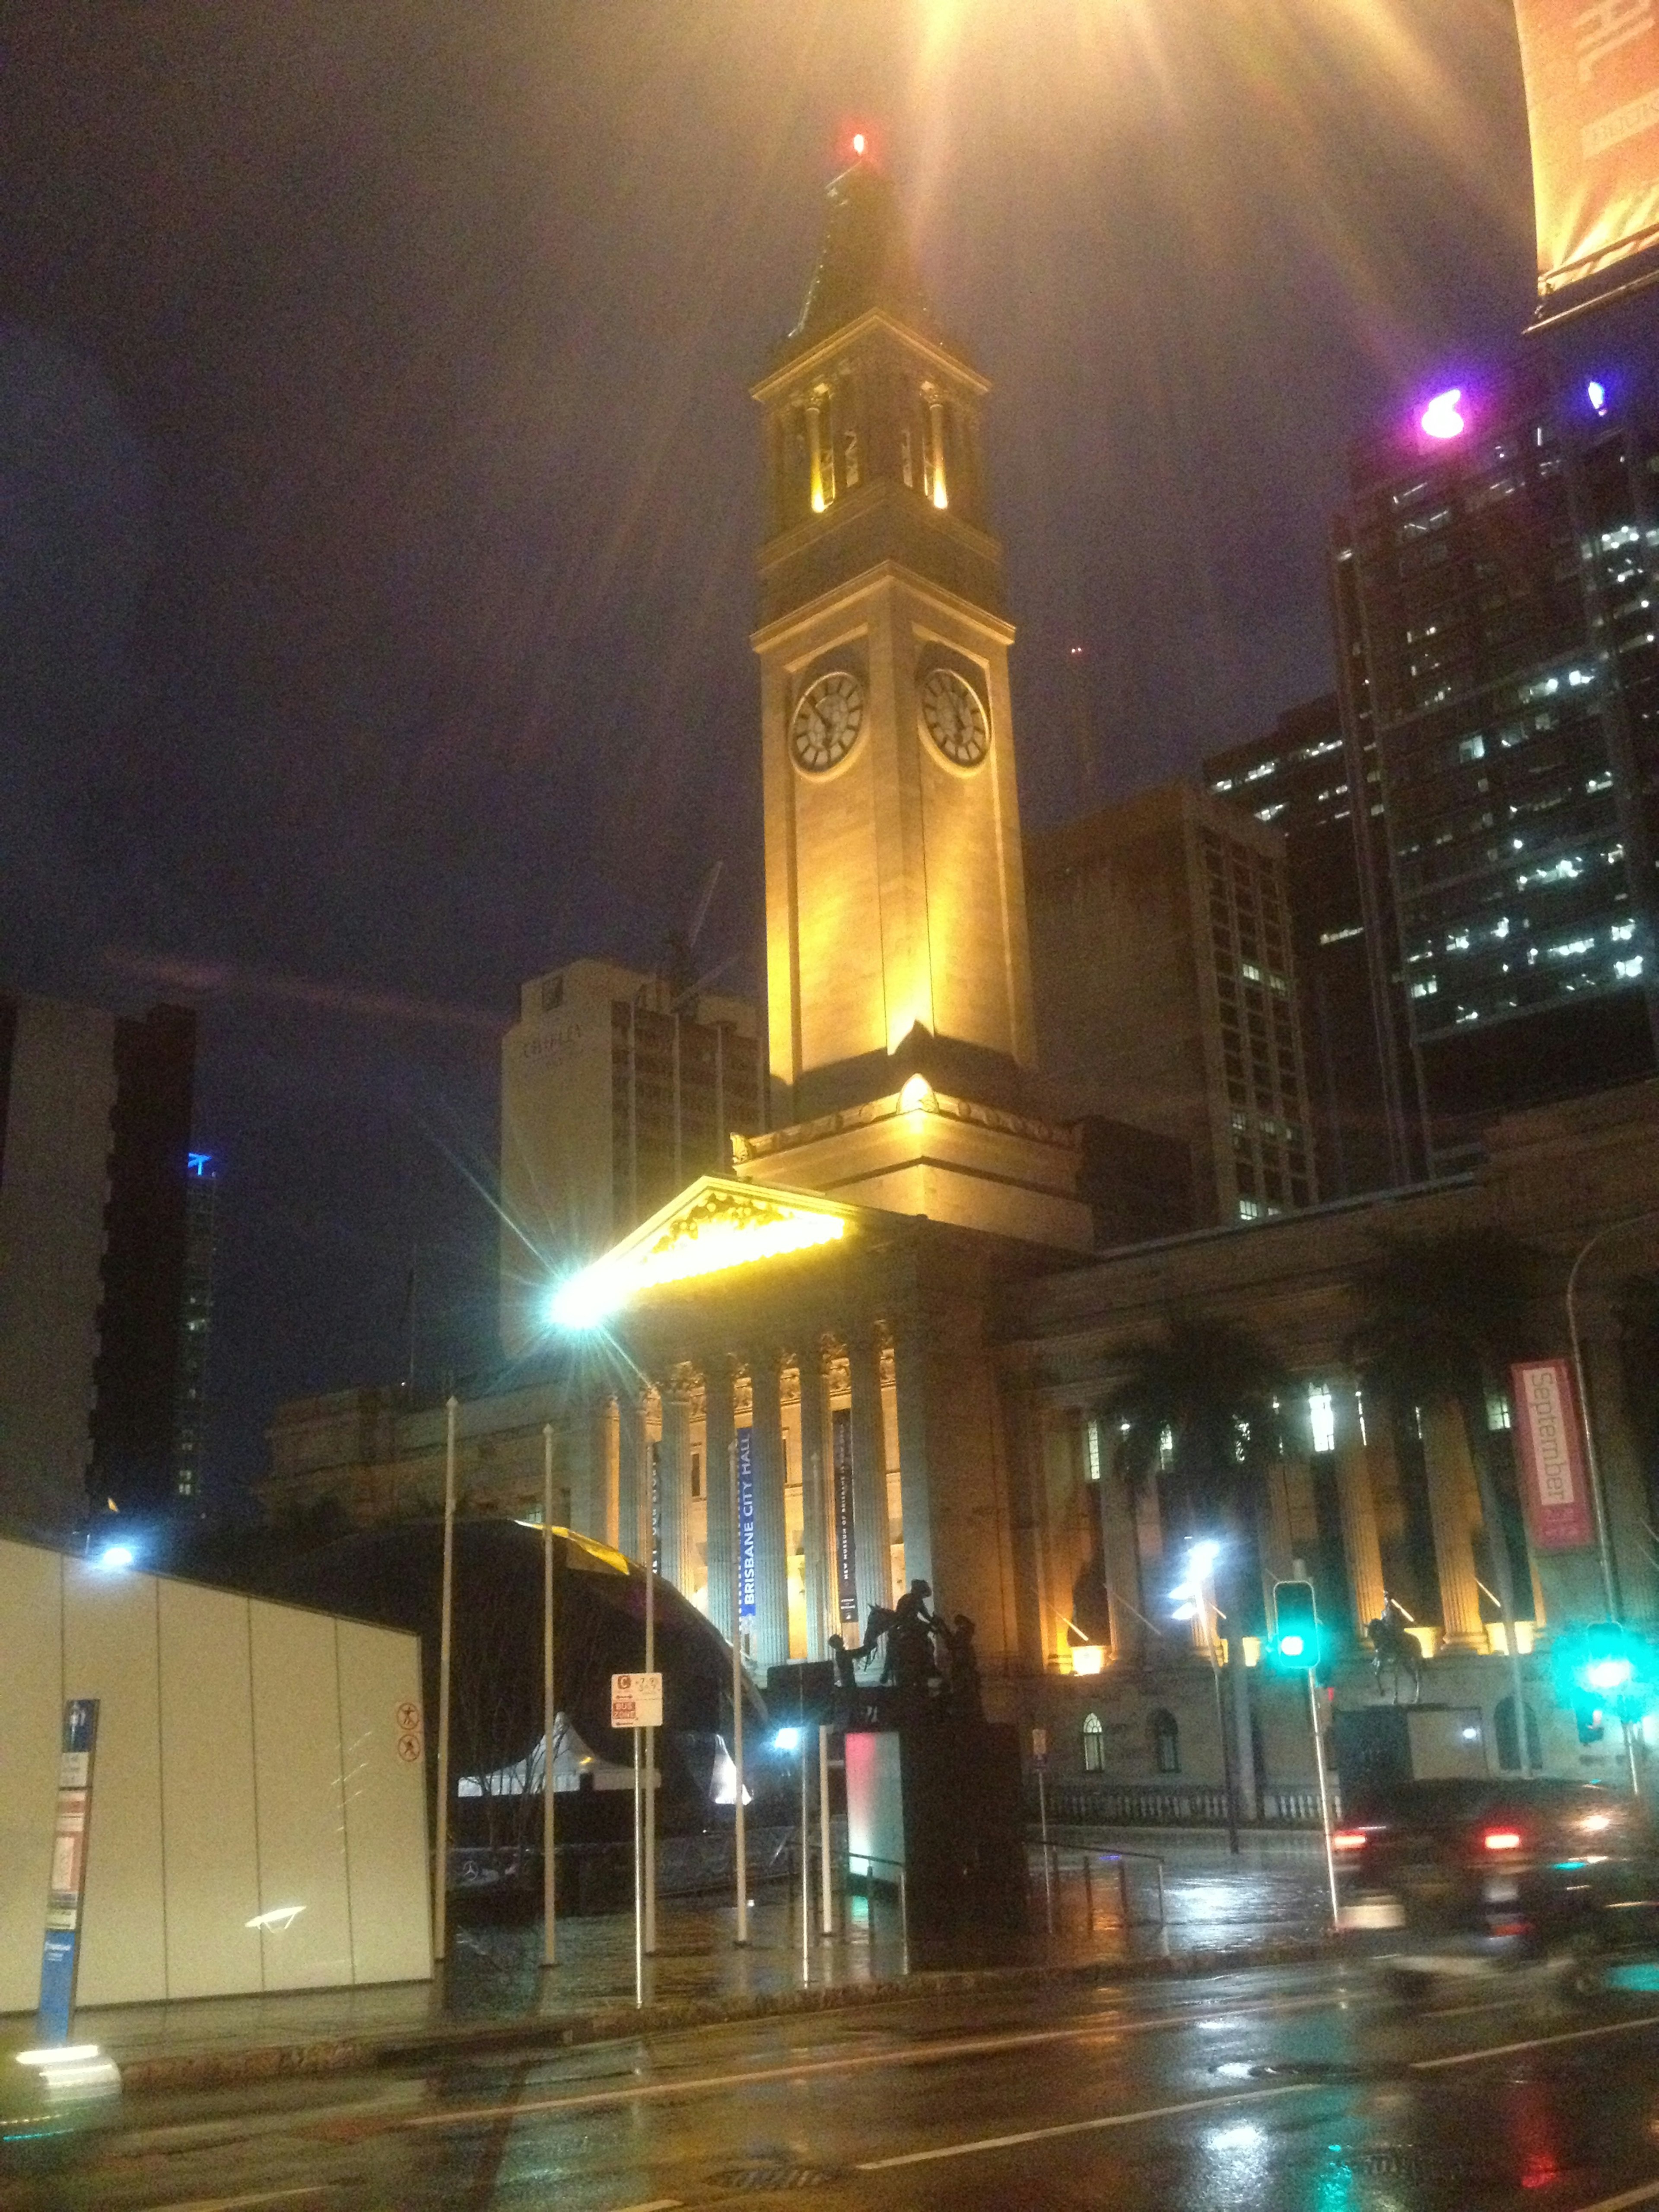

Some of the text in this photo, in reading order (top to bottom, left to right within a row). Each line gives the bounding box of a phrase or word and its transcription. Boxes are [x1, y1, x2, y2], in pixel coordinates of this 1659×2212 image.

[1529, 1371, 1566, 1501] September
[741, 1433, 755, 1605] BRISBANE CITY HALL
[842, 1516, 846, 1526] OF
